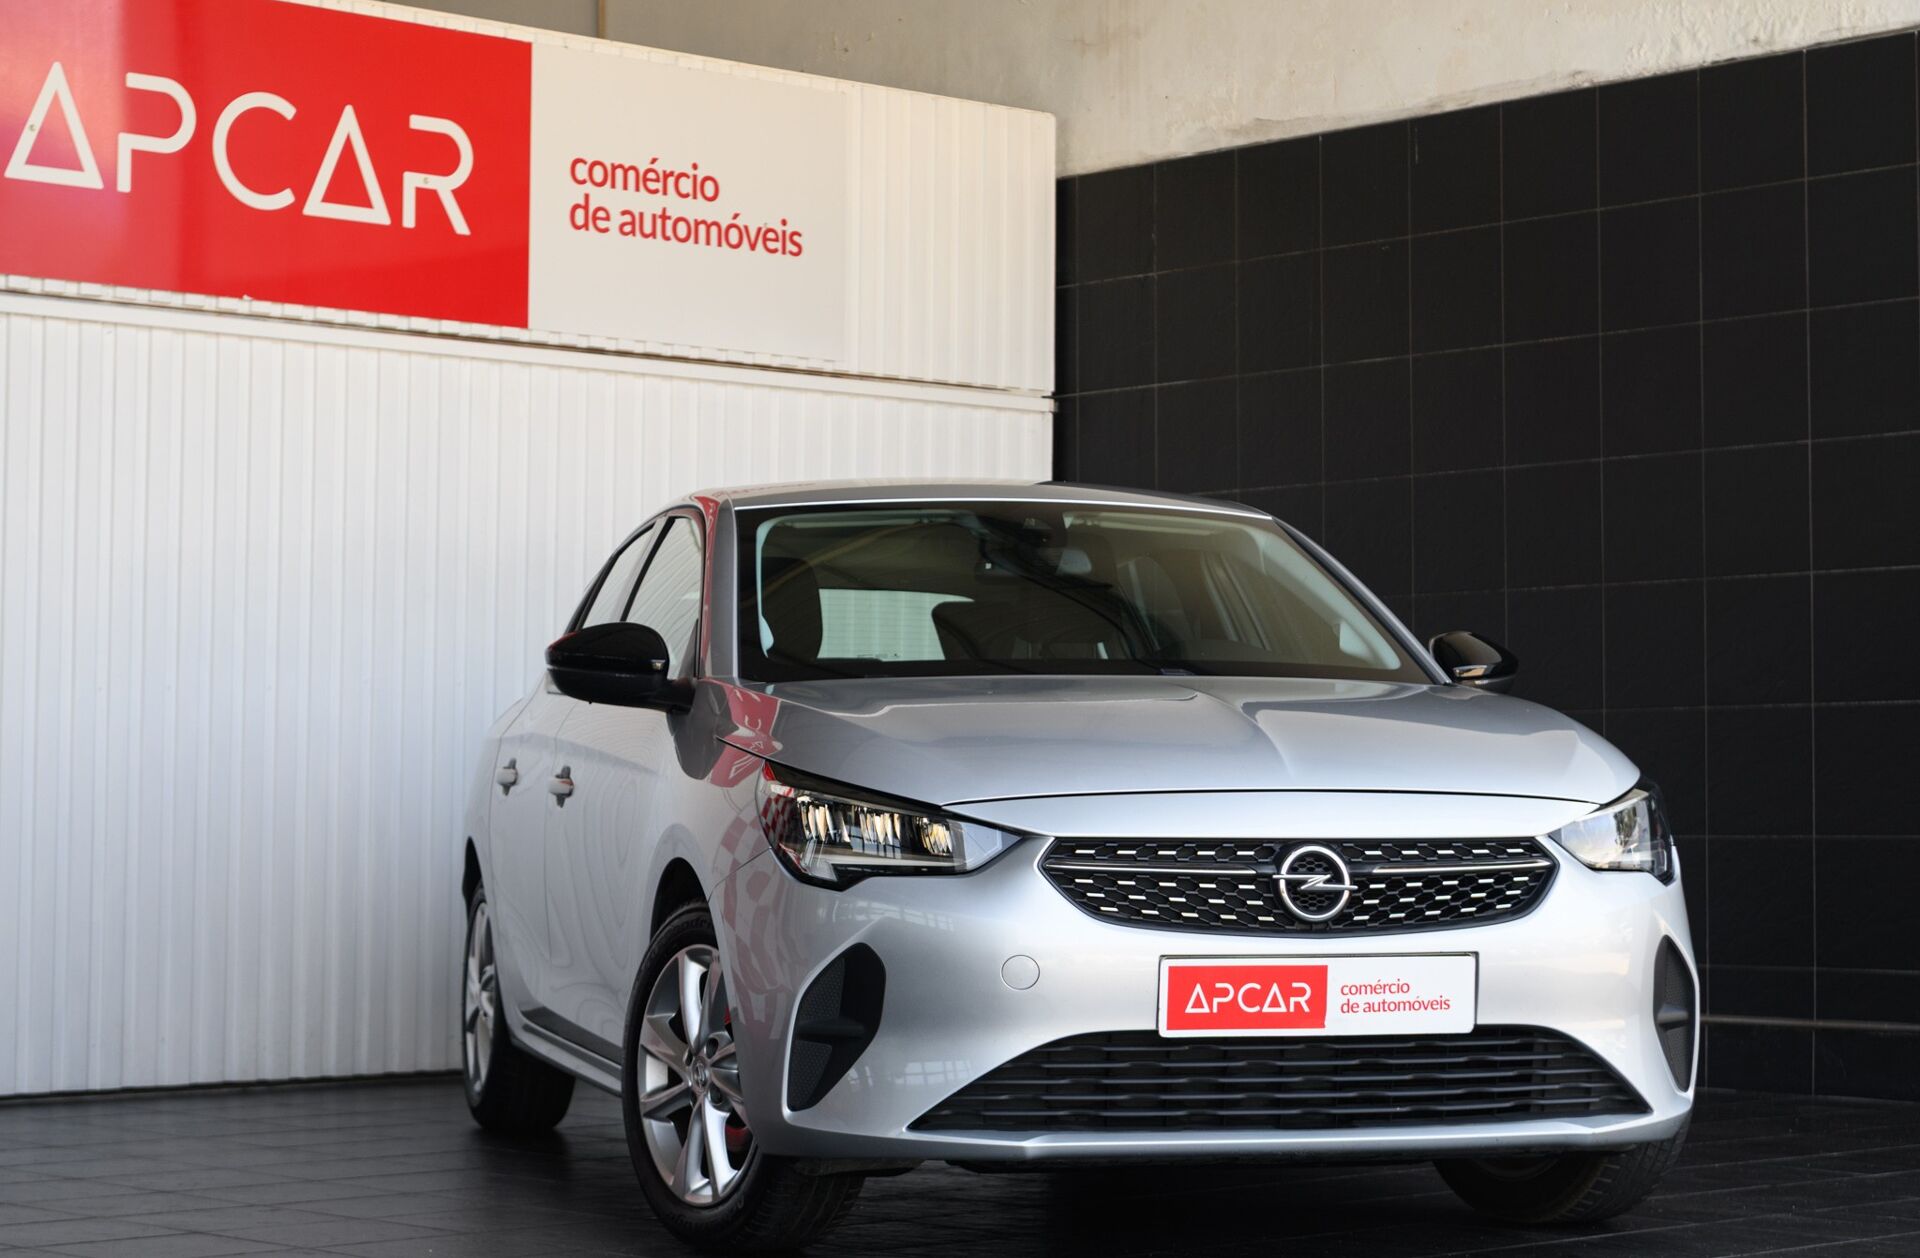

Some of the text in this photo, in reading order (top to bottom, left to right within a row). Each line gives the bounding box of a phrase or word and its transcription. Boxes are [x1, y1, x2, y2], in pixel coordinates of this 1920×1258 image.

[4, 61, 473, 235] APCAR
[570, 157, 720, 203] comércio
[570, 192, 803, 257] de automóveis
[1185, 982, 1311, 1013] APCAR
[1341, 978, 1410, 995] comércio
[1341, 995, 1451, 1014] de automóveis
